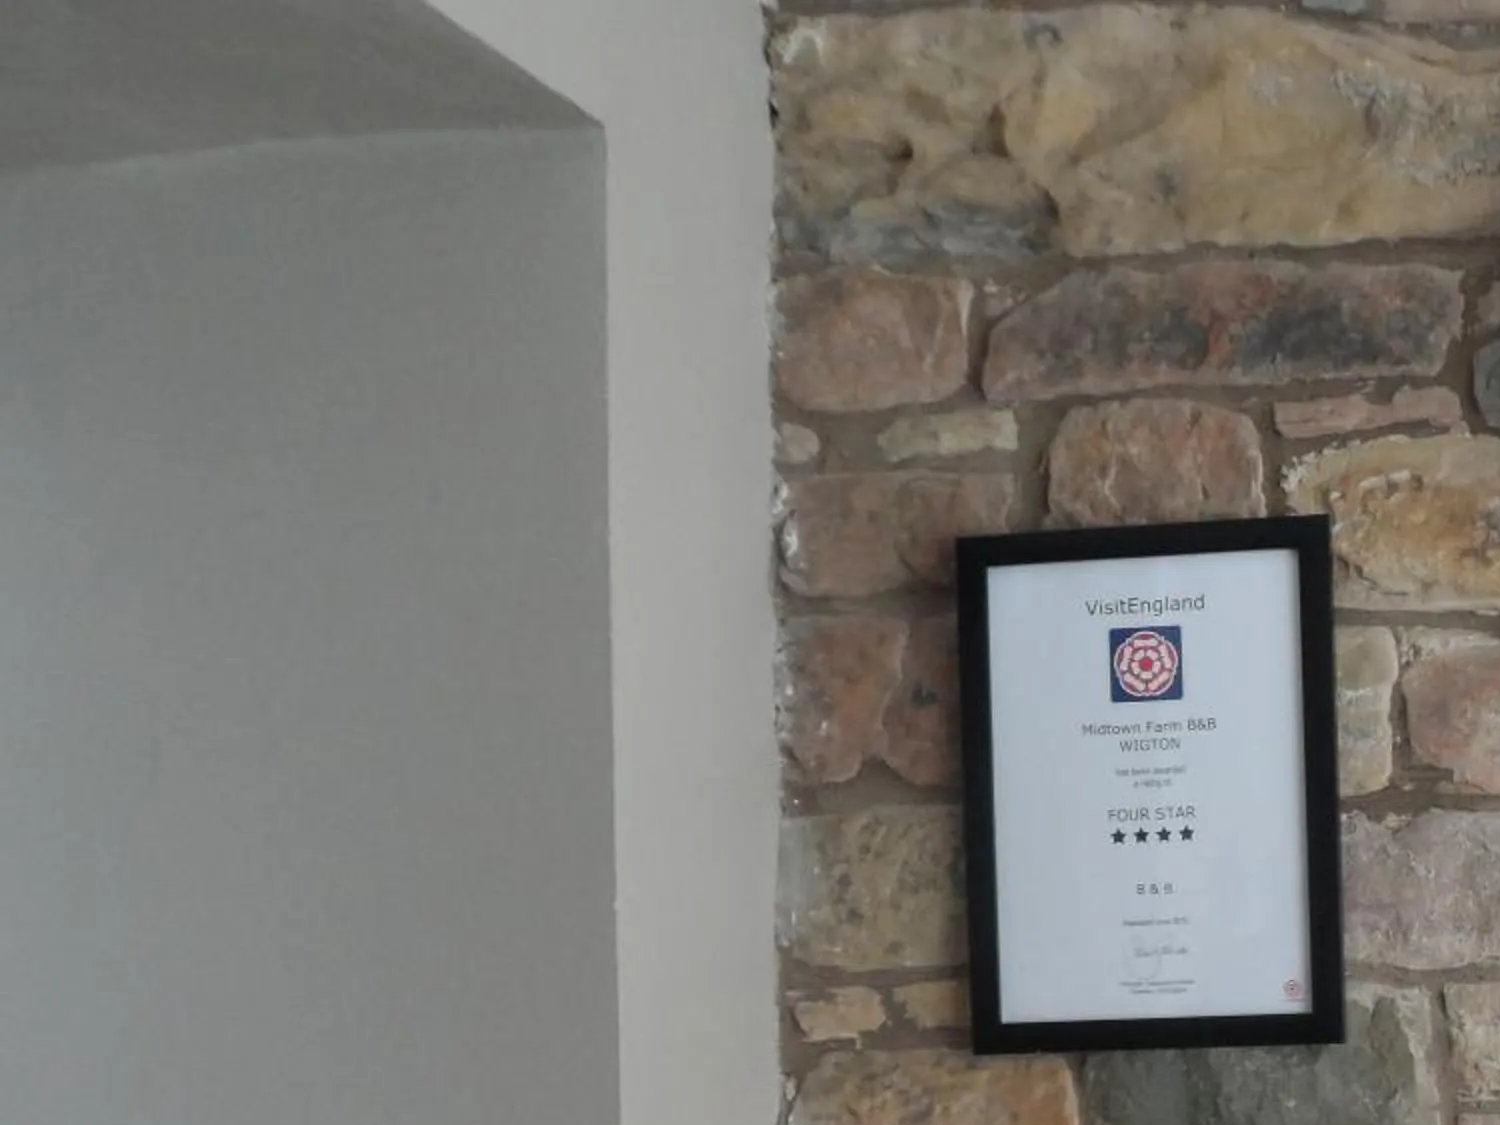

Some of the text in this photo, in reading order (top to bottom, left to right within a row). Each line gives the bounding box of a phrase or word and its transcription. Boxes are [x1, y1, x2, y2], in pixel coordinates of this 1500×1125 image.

[1085, 594, 1206, 616] VisitEngland
[1082, 717, 1218, 736] Midtown Farm B&B
[1119, 737, 1182, 753] WIGTON
[1107, 805, 1197, 823] FOUR STAR
